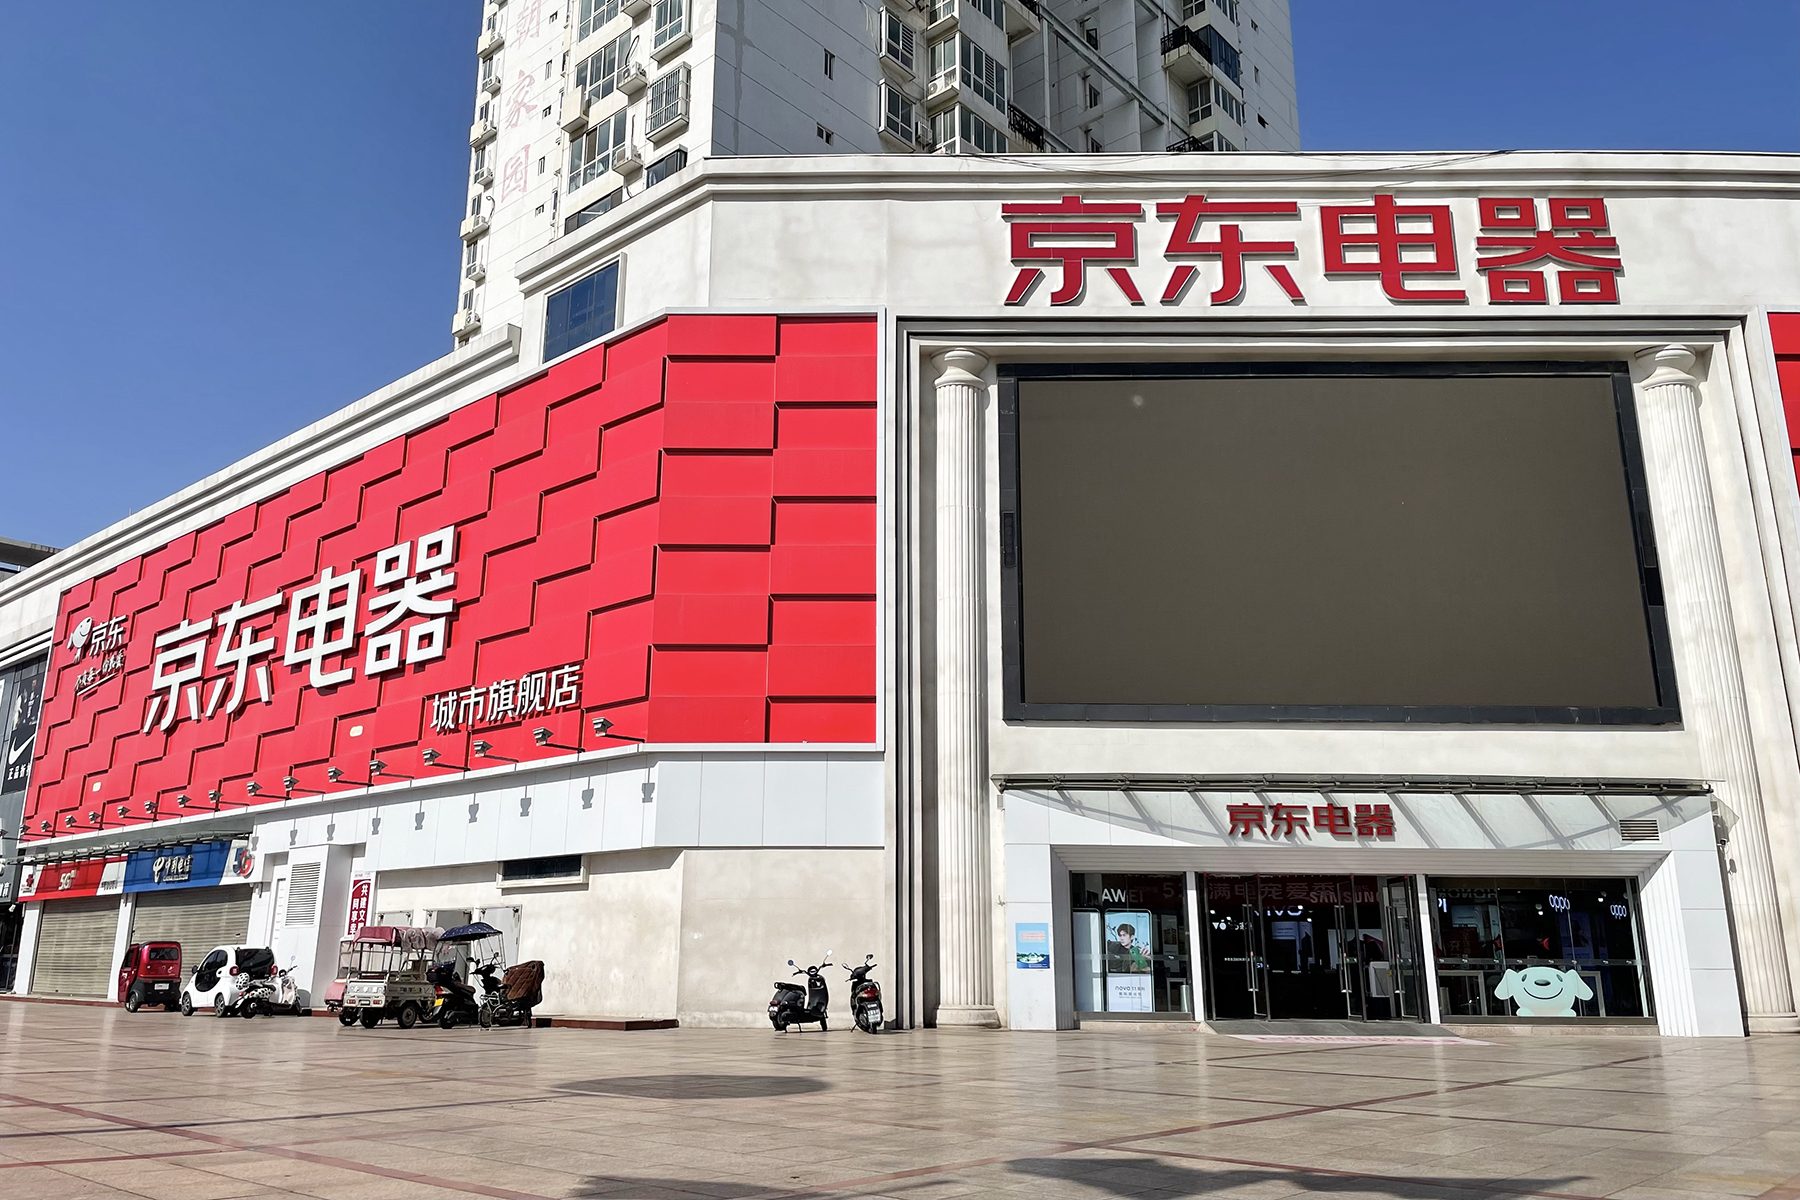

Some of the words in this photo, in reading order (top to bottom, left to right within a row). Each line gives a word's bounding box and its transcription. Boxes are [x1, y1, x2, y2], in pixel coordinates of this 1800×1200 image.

[1001, 194, 1624, 306] 京东电器
[89, 615, 127, 656] 京东
[143, 524, 457, 734] 京东电器
[430, 665, 581, 731] 城市旗舰店
[1227, 803, 1395, 838] 京东电器
